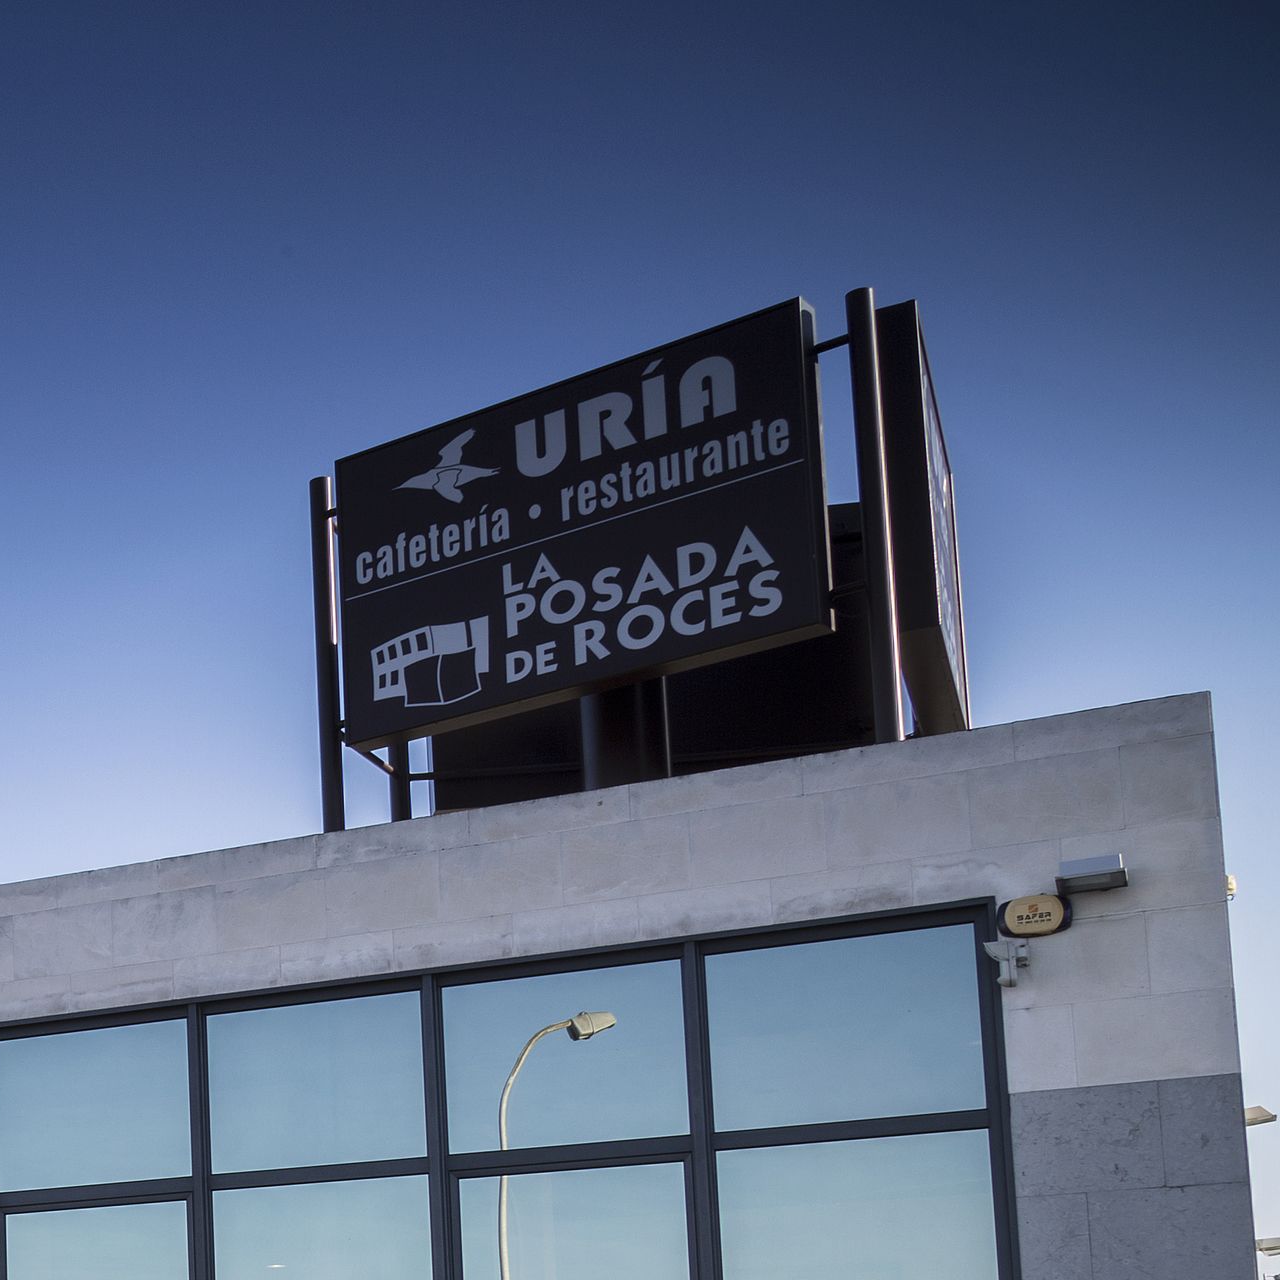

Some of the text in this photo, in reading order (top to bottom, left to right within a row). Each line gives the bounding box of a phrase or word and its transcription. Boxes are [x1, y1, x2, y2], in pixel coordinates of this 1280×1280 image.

[514, 355, 737, 478] URÍA
[355, 417, 789, 585] cafetería restaurante
[502, 552, 561, 595] LA
[505, 525, 775, 639] POSADA
[505, 569, 783, 684] DE ROCES
[1016, 912, 1051, 921] SAFER
